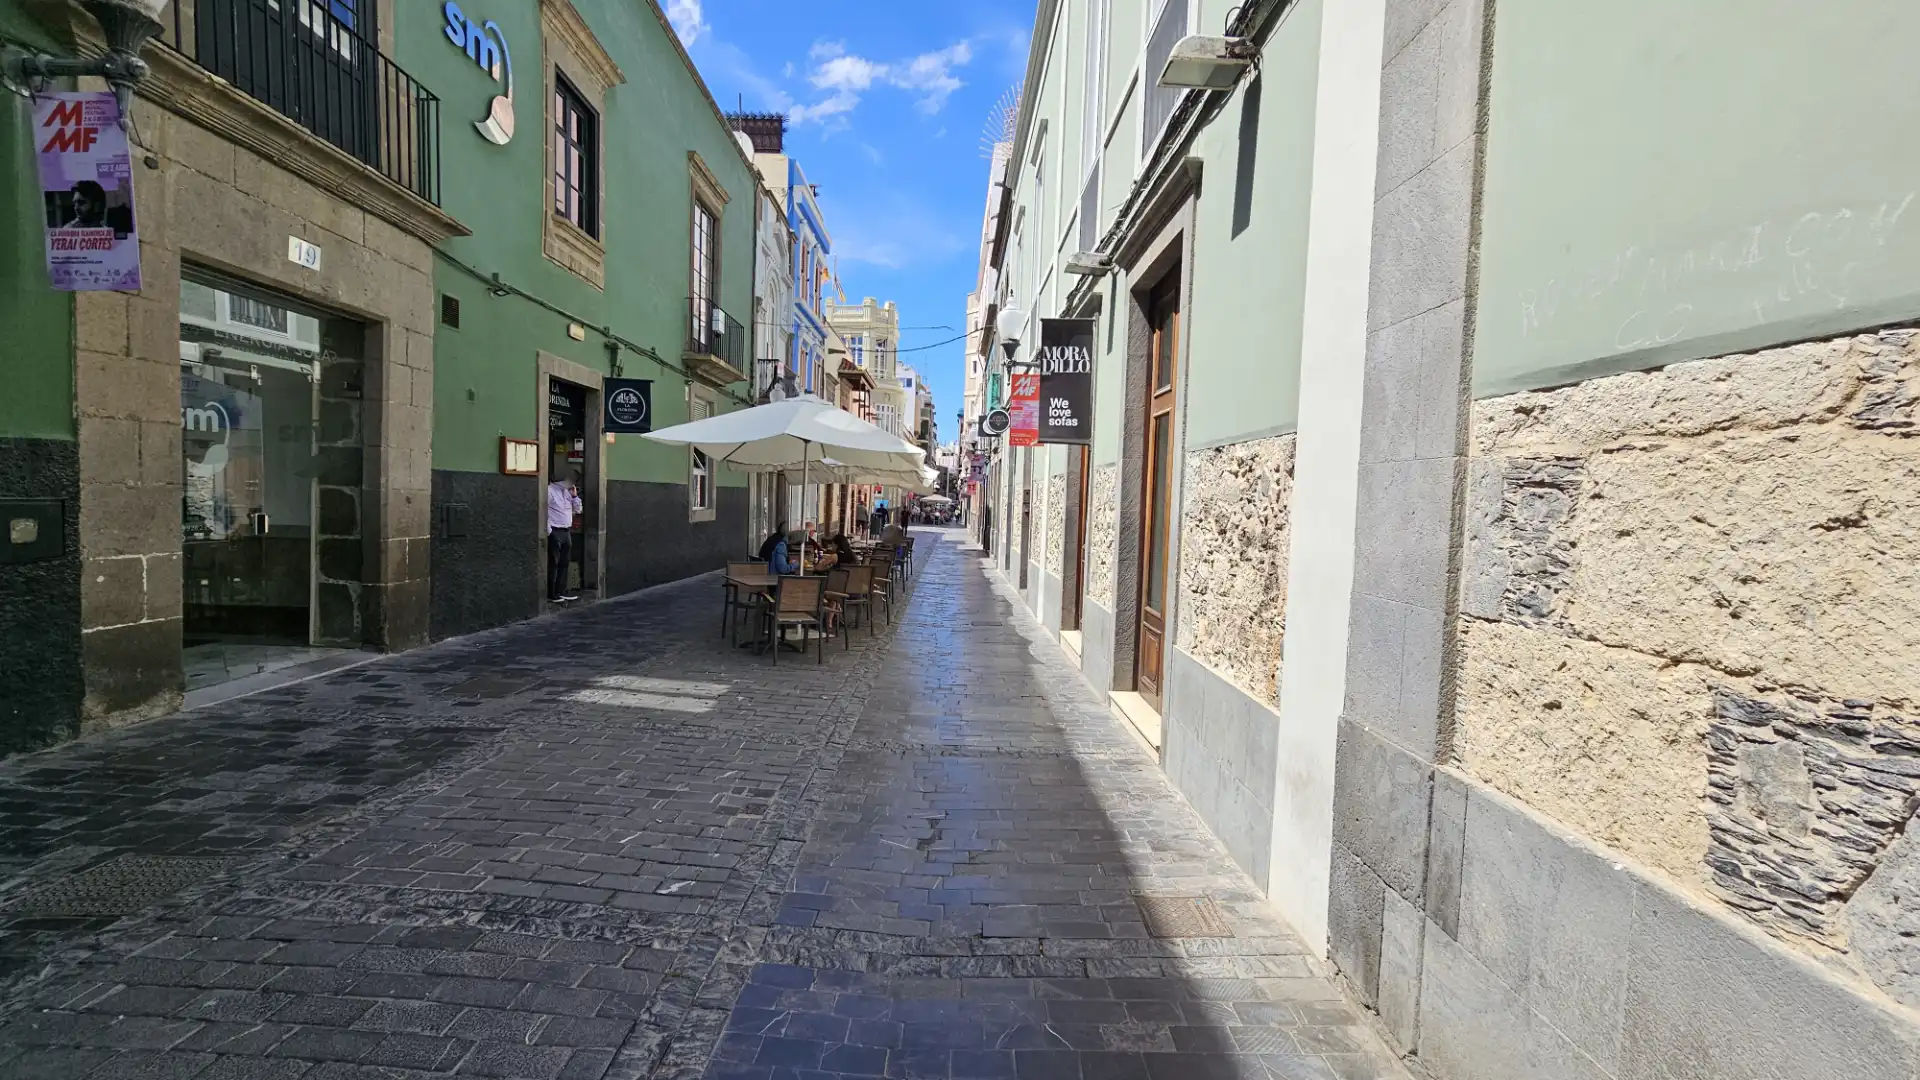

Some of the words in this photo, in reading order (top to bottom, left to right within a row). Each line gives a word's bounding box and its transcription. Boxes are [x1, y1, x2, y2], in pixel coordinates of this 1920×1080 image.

[445, 1, 500, 82] sm
[41, 127, 98, 153] MF
[294, 241, 317, 266] 19
[1043, 346, 1090, 361] MORA
[1043, 359, 1091, 373] DILLO
[1050, 397, 1069, 409] We
[1049, 408, 1072, 418] love
[1049, 418, 1078, 427] sofas
